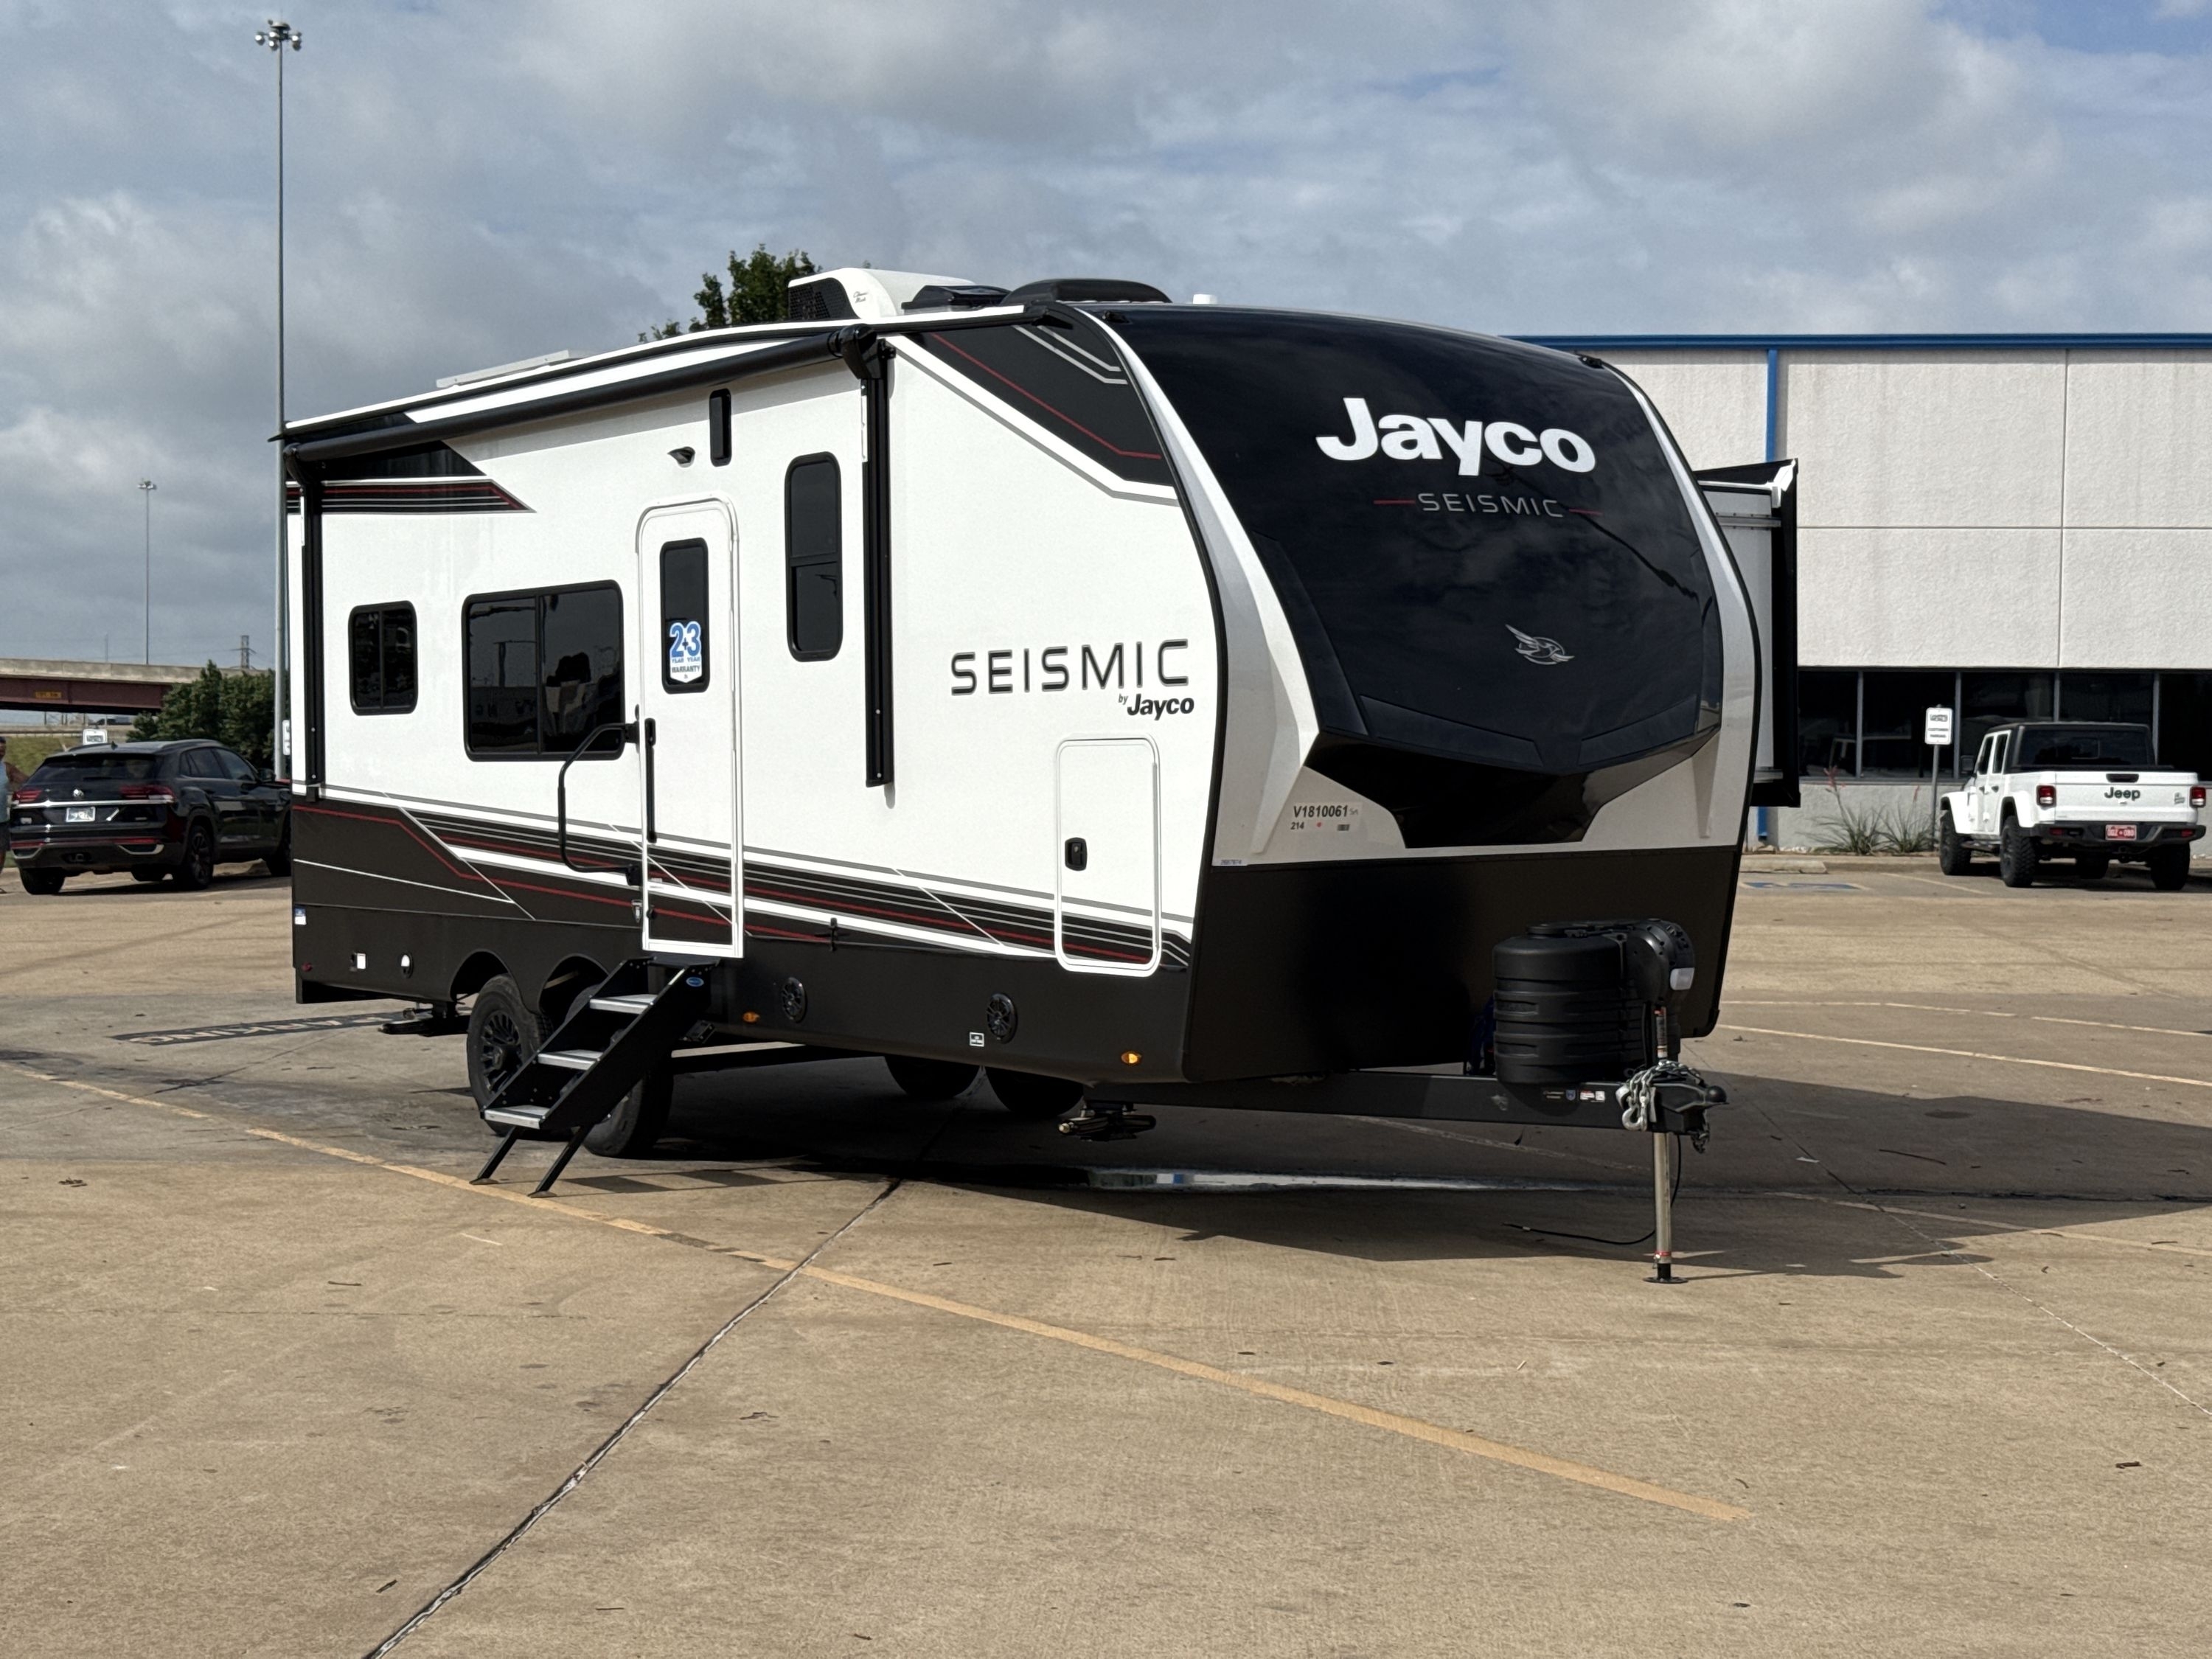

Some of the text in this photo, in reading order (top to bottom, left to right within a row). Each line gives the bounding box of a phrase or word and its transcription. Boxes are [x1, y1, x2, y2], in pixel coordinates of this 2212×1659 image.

[1316, 397, 1596, 476] Jayco
[1417, 493, 1564, 518] SEISMIC
[951, 639, 1189, 695] SEISMIC
[1118, 694, 1194, 720] by Jayco
[2104, 787, 2140, 801] Jeep
[1293, 805, 1348, 818] V1810061
[1290, 821, 1304, 830] 214
